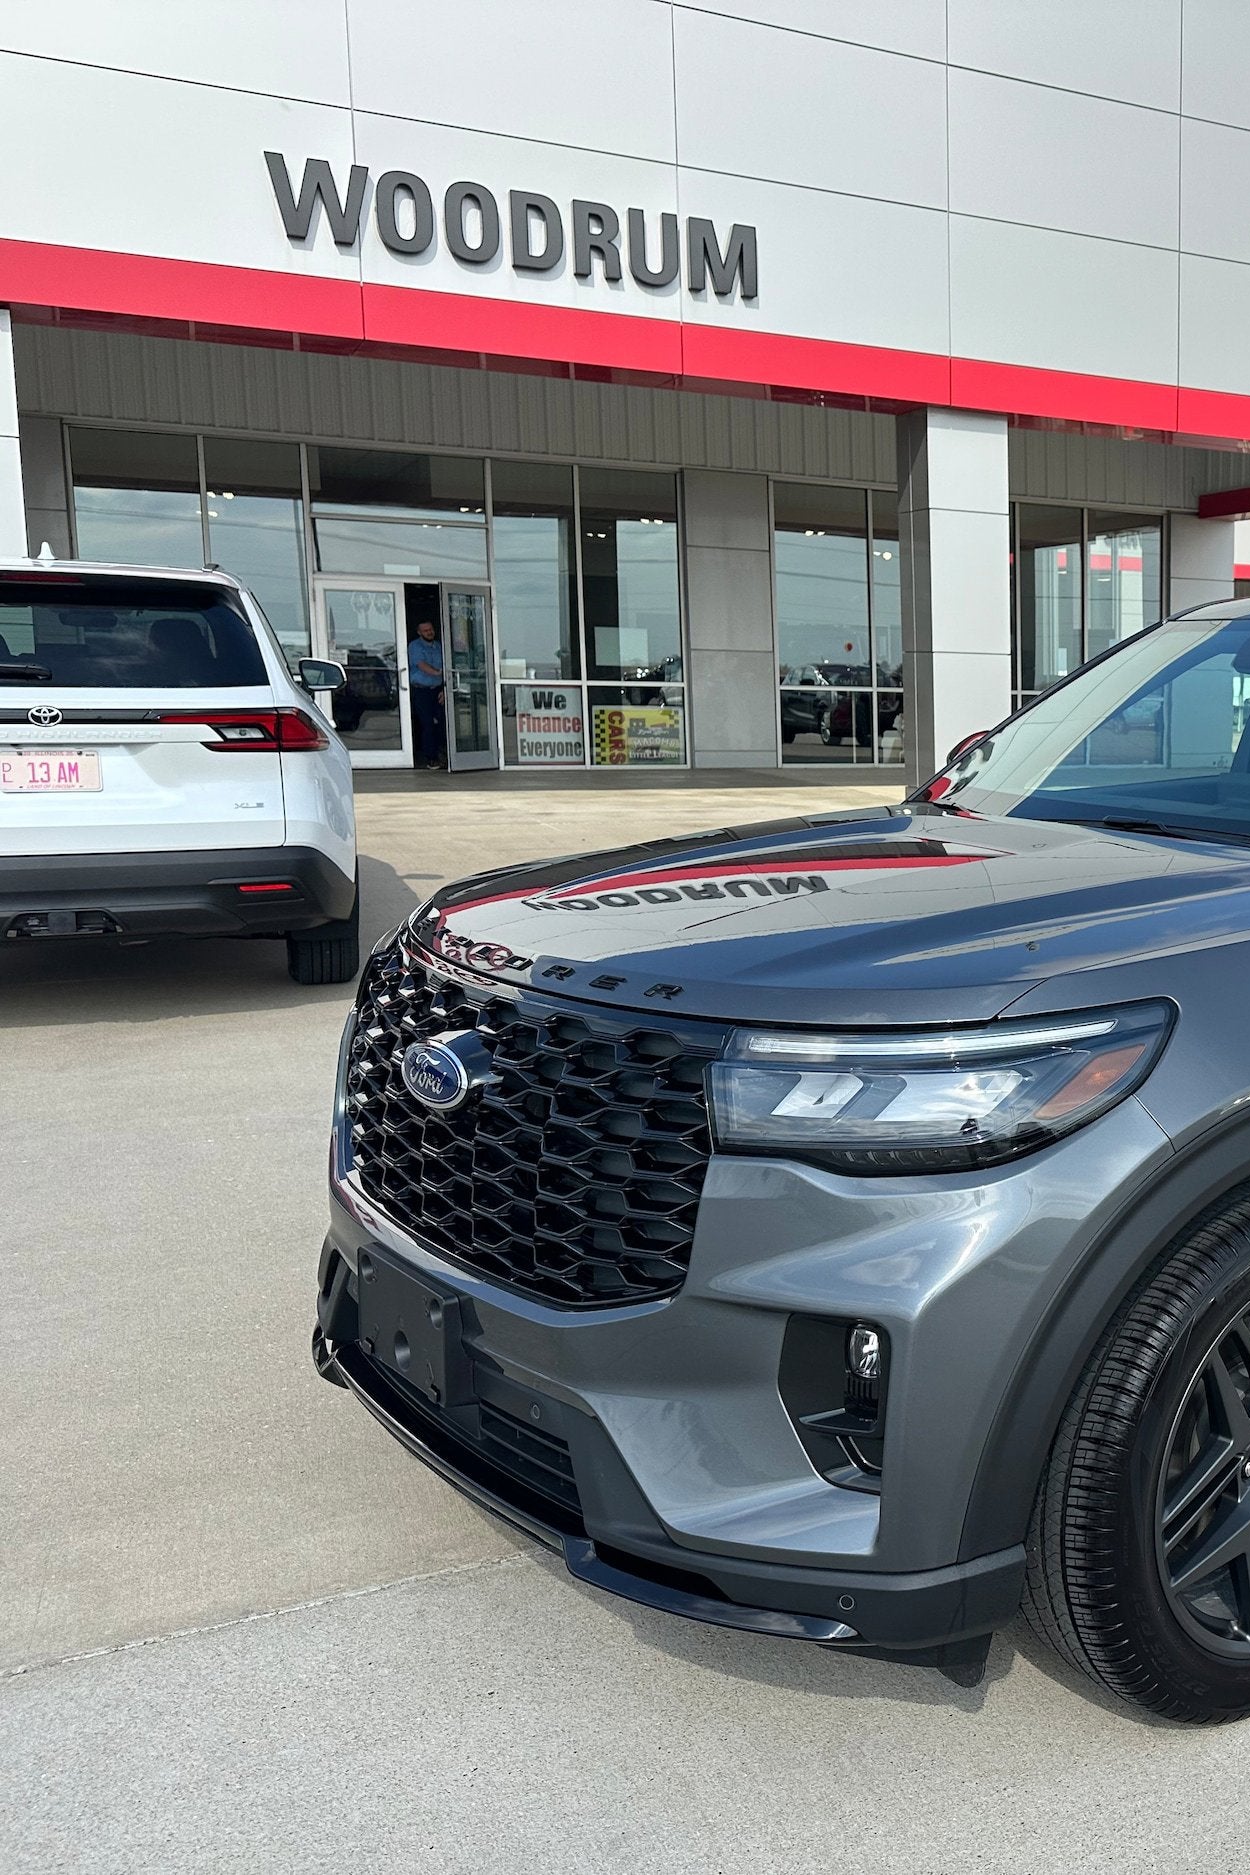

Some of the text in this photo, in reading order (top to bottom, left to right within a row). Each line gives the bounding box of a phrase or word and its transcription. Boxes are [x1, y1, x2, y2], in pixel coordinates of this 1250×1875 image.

[263, 150, 758, 299] WOODRUM
[531, 691, 567, 710] We
[518, 713, 582, 733] Finance
[16, 730, 163, 739] HIGHLANDER
[608, 711, 627, 764] CARS
[520, 738, 582, 758] Everyone
[27, 762, 79, 783] 13 AM
[410, 1052, 447, 1095] Ford
